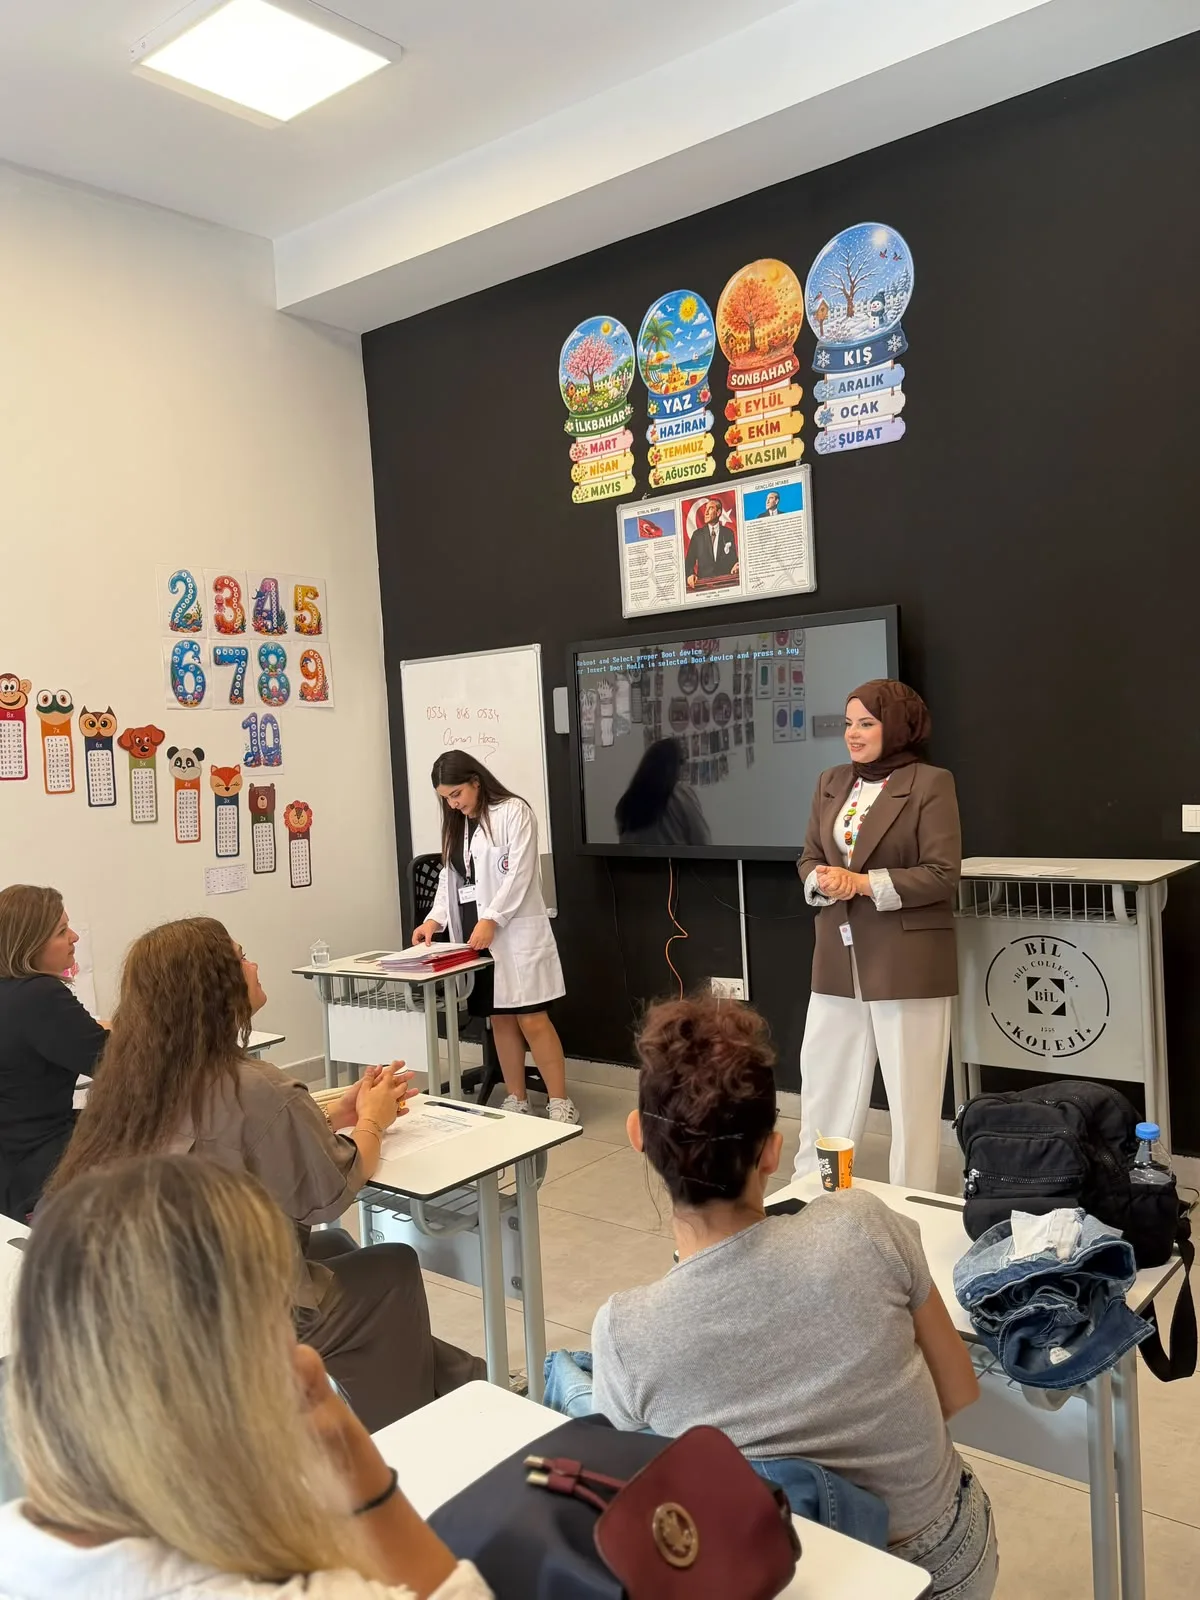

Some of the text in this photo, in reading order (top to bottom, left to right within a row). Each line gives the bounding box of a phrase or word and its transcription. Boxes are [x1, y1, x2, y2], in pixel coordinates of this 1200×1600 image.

[844, 346, 872, 366] KIŞ
[731, 360, 794, 386] SONBAHAR
[838, 373, 884, 394] ARALIK
[663, 394, 692, 413] YAZ
[745, 393, 784, 414] EYLÜL
[840, 401, 879, 418] OCAK
[575, 411, 625, 433] İLKBAHAR
[660, 417, 706, 438] HAZİRAN
[747, 421, 781, 439] EKİM
[589, 438, 617, 454] MART
[839, 427, 882, 448] ŞUBAT
[664, 440, 703, 459] TEMMUZ
[745, 446, 787, 466] KASIM
[589, 460, 618, 476] NİSAN
[665, 463, 706, 481] AĞUSTOS
[591, 481, 621, 497] MAYIS
[168, 569, 203, 633] 2
[213, 575, 247, 636] 3
[251, 577, 288, 636] 4
[294, 585, 323, 636] 5
[612, 655, 633, 663] Select
[636, 653, 658, 662] proper
[679, 648, 702, 656] device
[658, 658, 688, 667] selected
[691, 656, 706, 664] Boot
[709, 654, 734, 662] device
[753, 650, 774, 659] press
[786, 647, 799, 655] key
[170, 639, 206, 708] 6
[213, 646, 249, 705] 7
[257, 641, 291, 707] 8
[299, 649, 329, 702] 9
[426, 706, 447, 720] 0534
[477, 708, 500, 723] 0534
[241, 711, 283, 768] 10
[1024, 938, 1062, 958] BİL
[1014, 960, 1075, 983] BİL COLLEGE
[1034, 988, 1059, 1003] BİL
[1011, 1026, 1086, 1051] KOLEJİ
